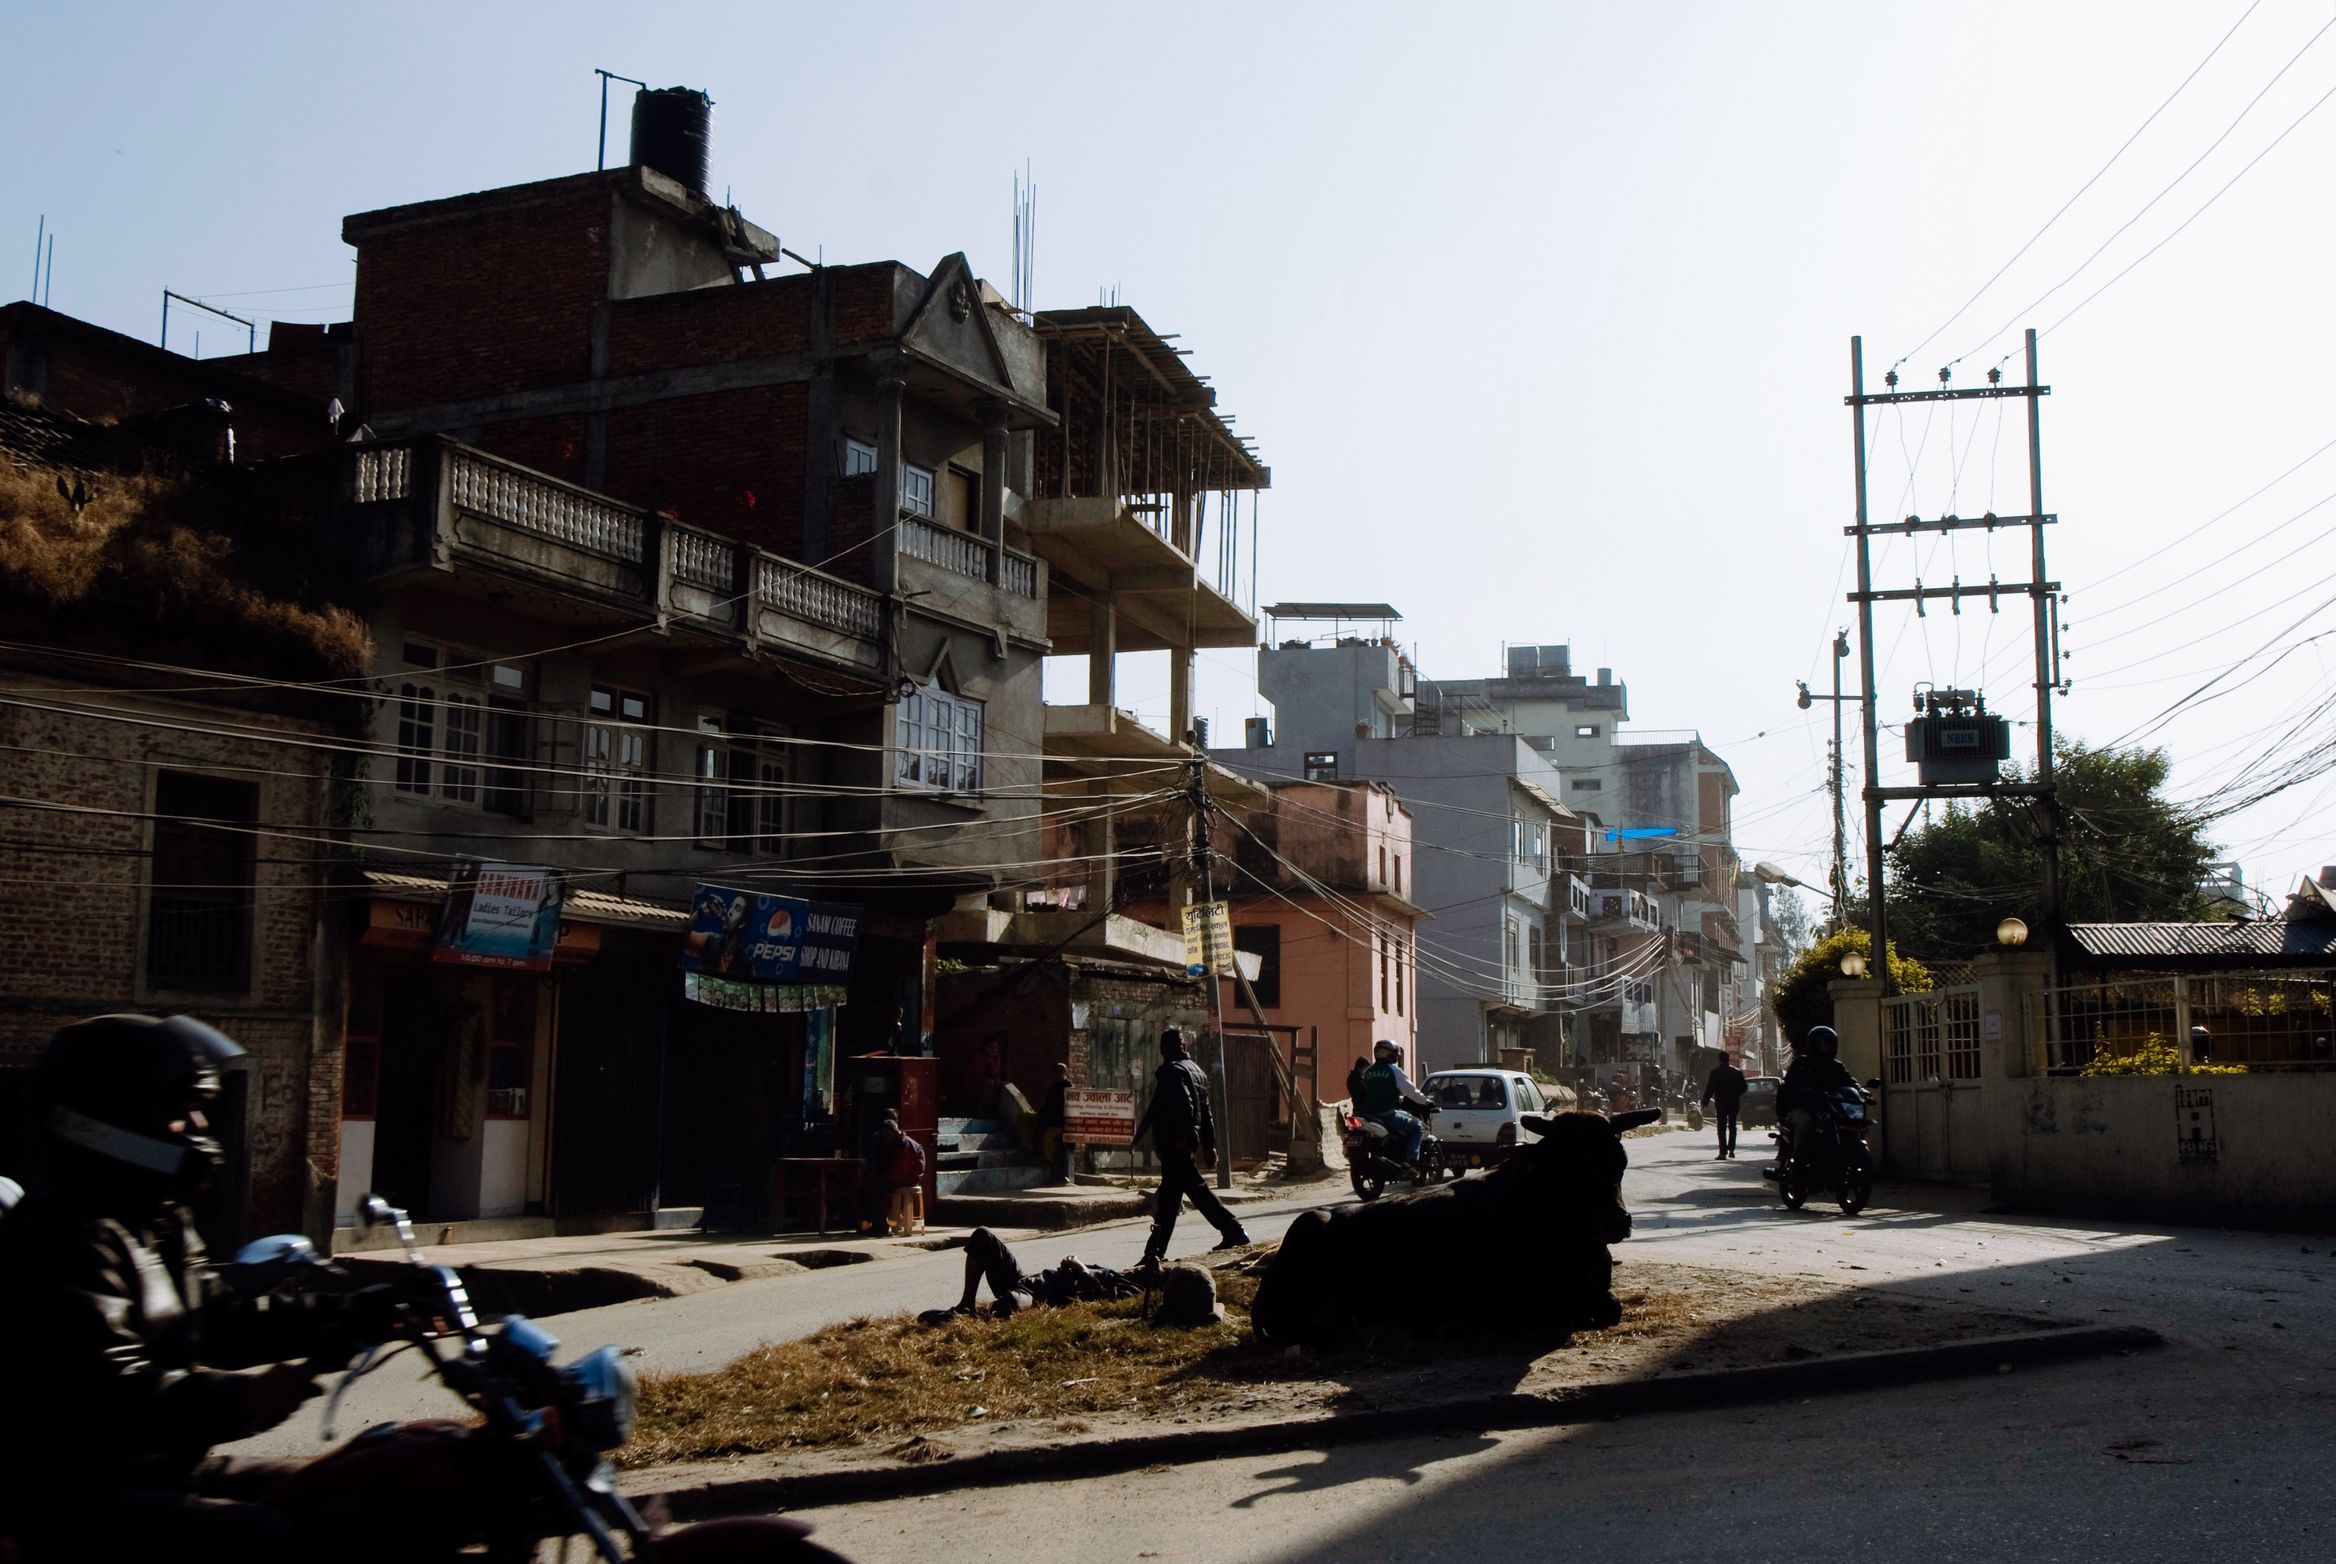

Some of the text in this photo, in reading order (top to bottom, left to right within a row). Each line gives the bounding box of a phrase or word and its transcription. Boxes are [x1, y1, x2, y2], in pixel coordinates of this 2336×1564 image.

[473, 902, 533, 919] Ladies Tailors
[831, 916, 857, 937] COFFEE
[752, 942, 797, 962] PEPSI
[799, 945, 817, 968] SHOP
[816, 947, 830, 969] AND
